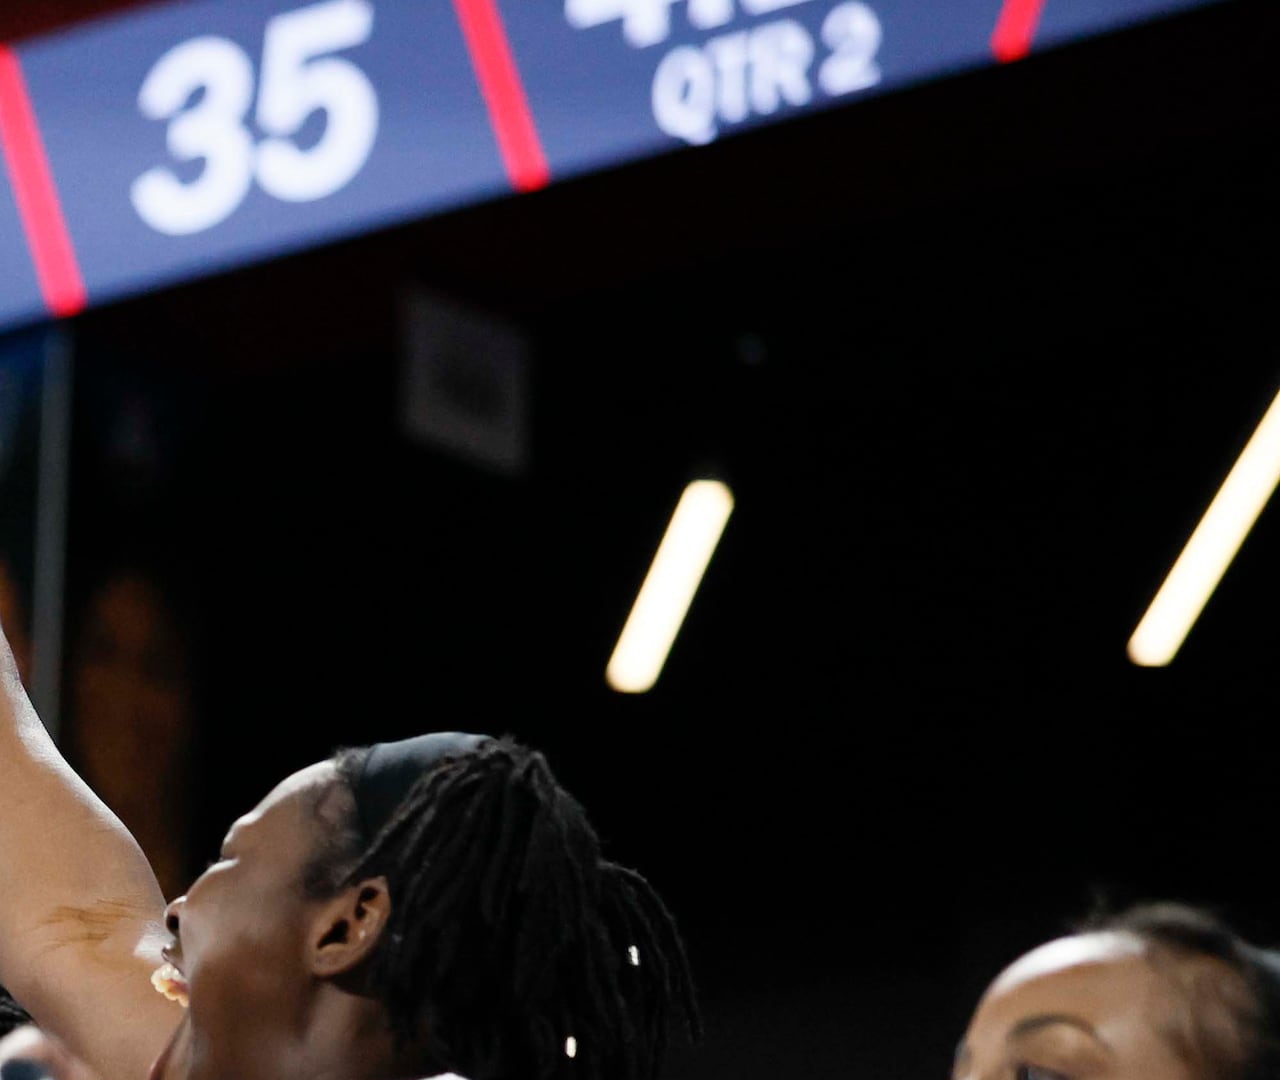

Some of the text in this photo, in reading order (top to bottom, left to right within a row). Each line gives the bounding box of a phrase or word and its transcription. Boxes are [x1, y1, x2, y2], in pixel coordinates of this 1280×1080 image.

[130, 0, 379, 235] 35
[651, 19, 815, 145] QTR
[818, 2, 882, 96] 2
